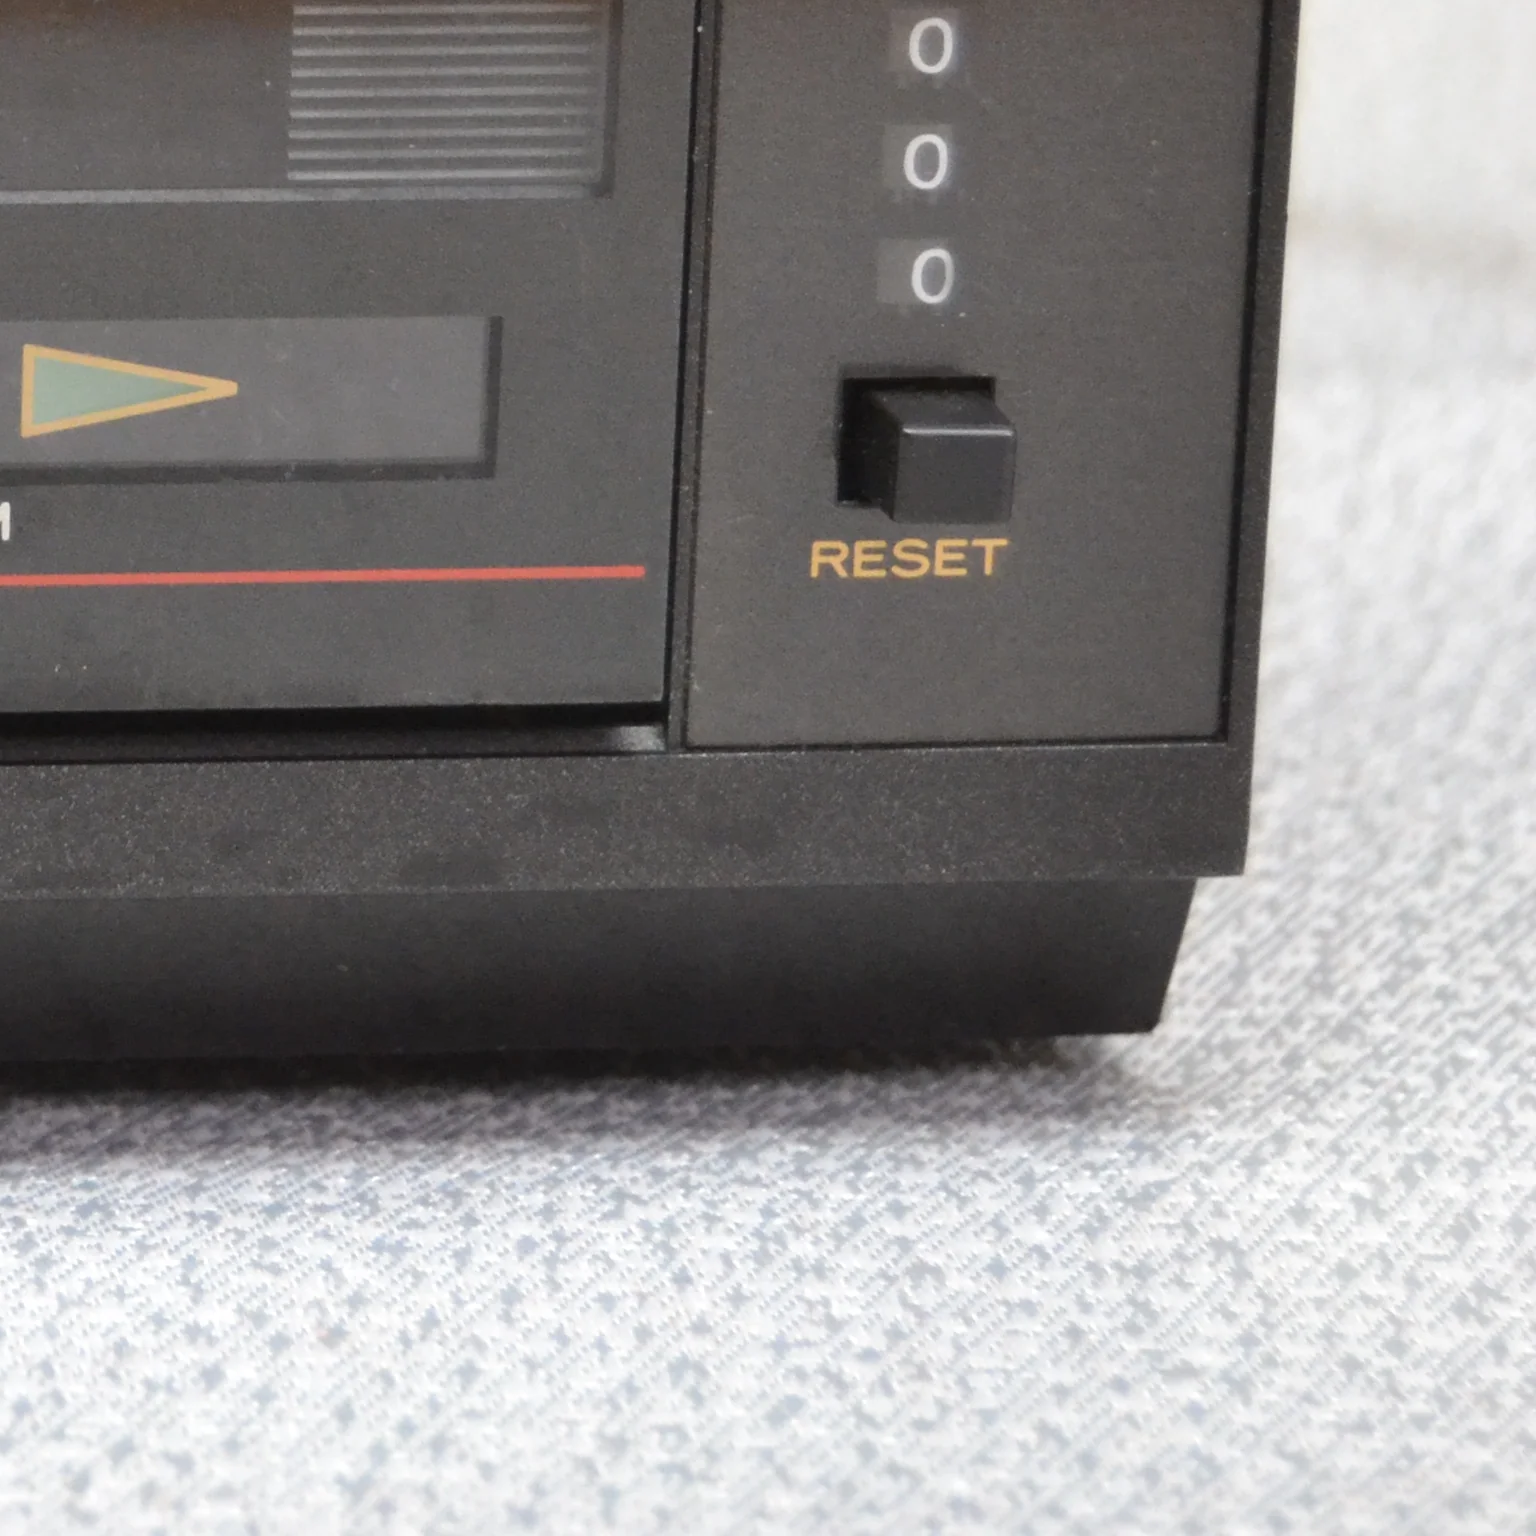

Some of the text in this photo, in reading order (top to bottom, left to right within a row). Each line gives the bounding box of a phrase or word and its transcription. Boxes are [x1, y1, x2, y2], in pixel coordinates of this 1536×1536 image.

[903, 16, 954, 304] 0 0 0
[810, 537, 1009, 579] RESET
